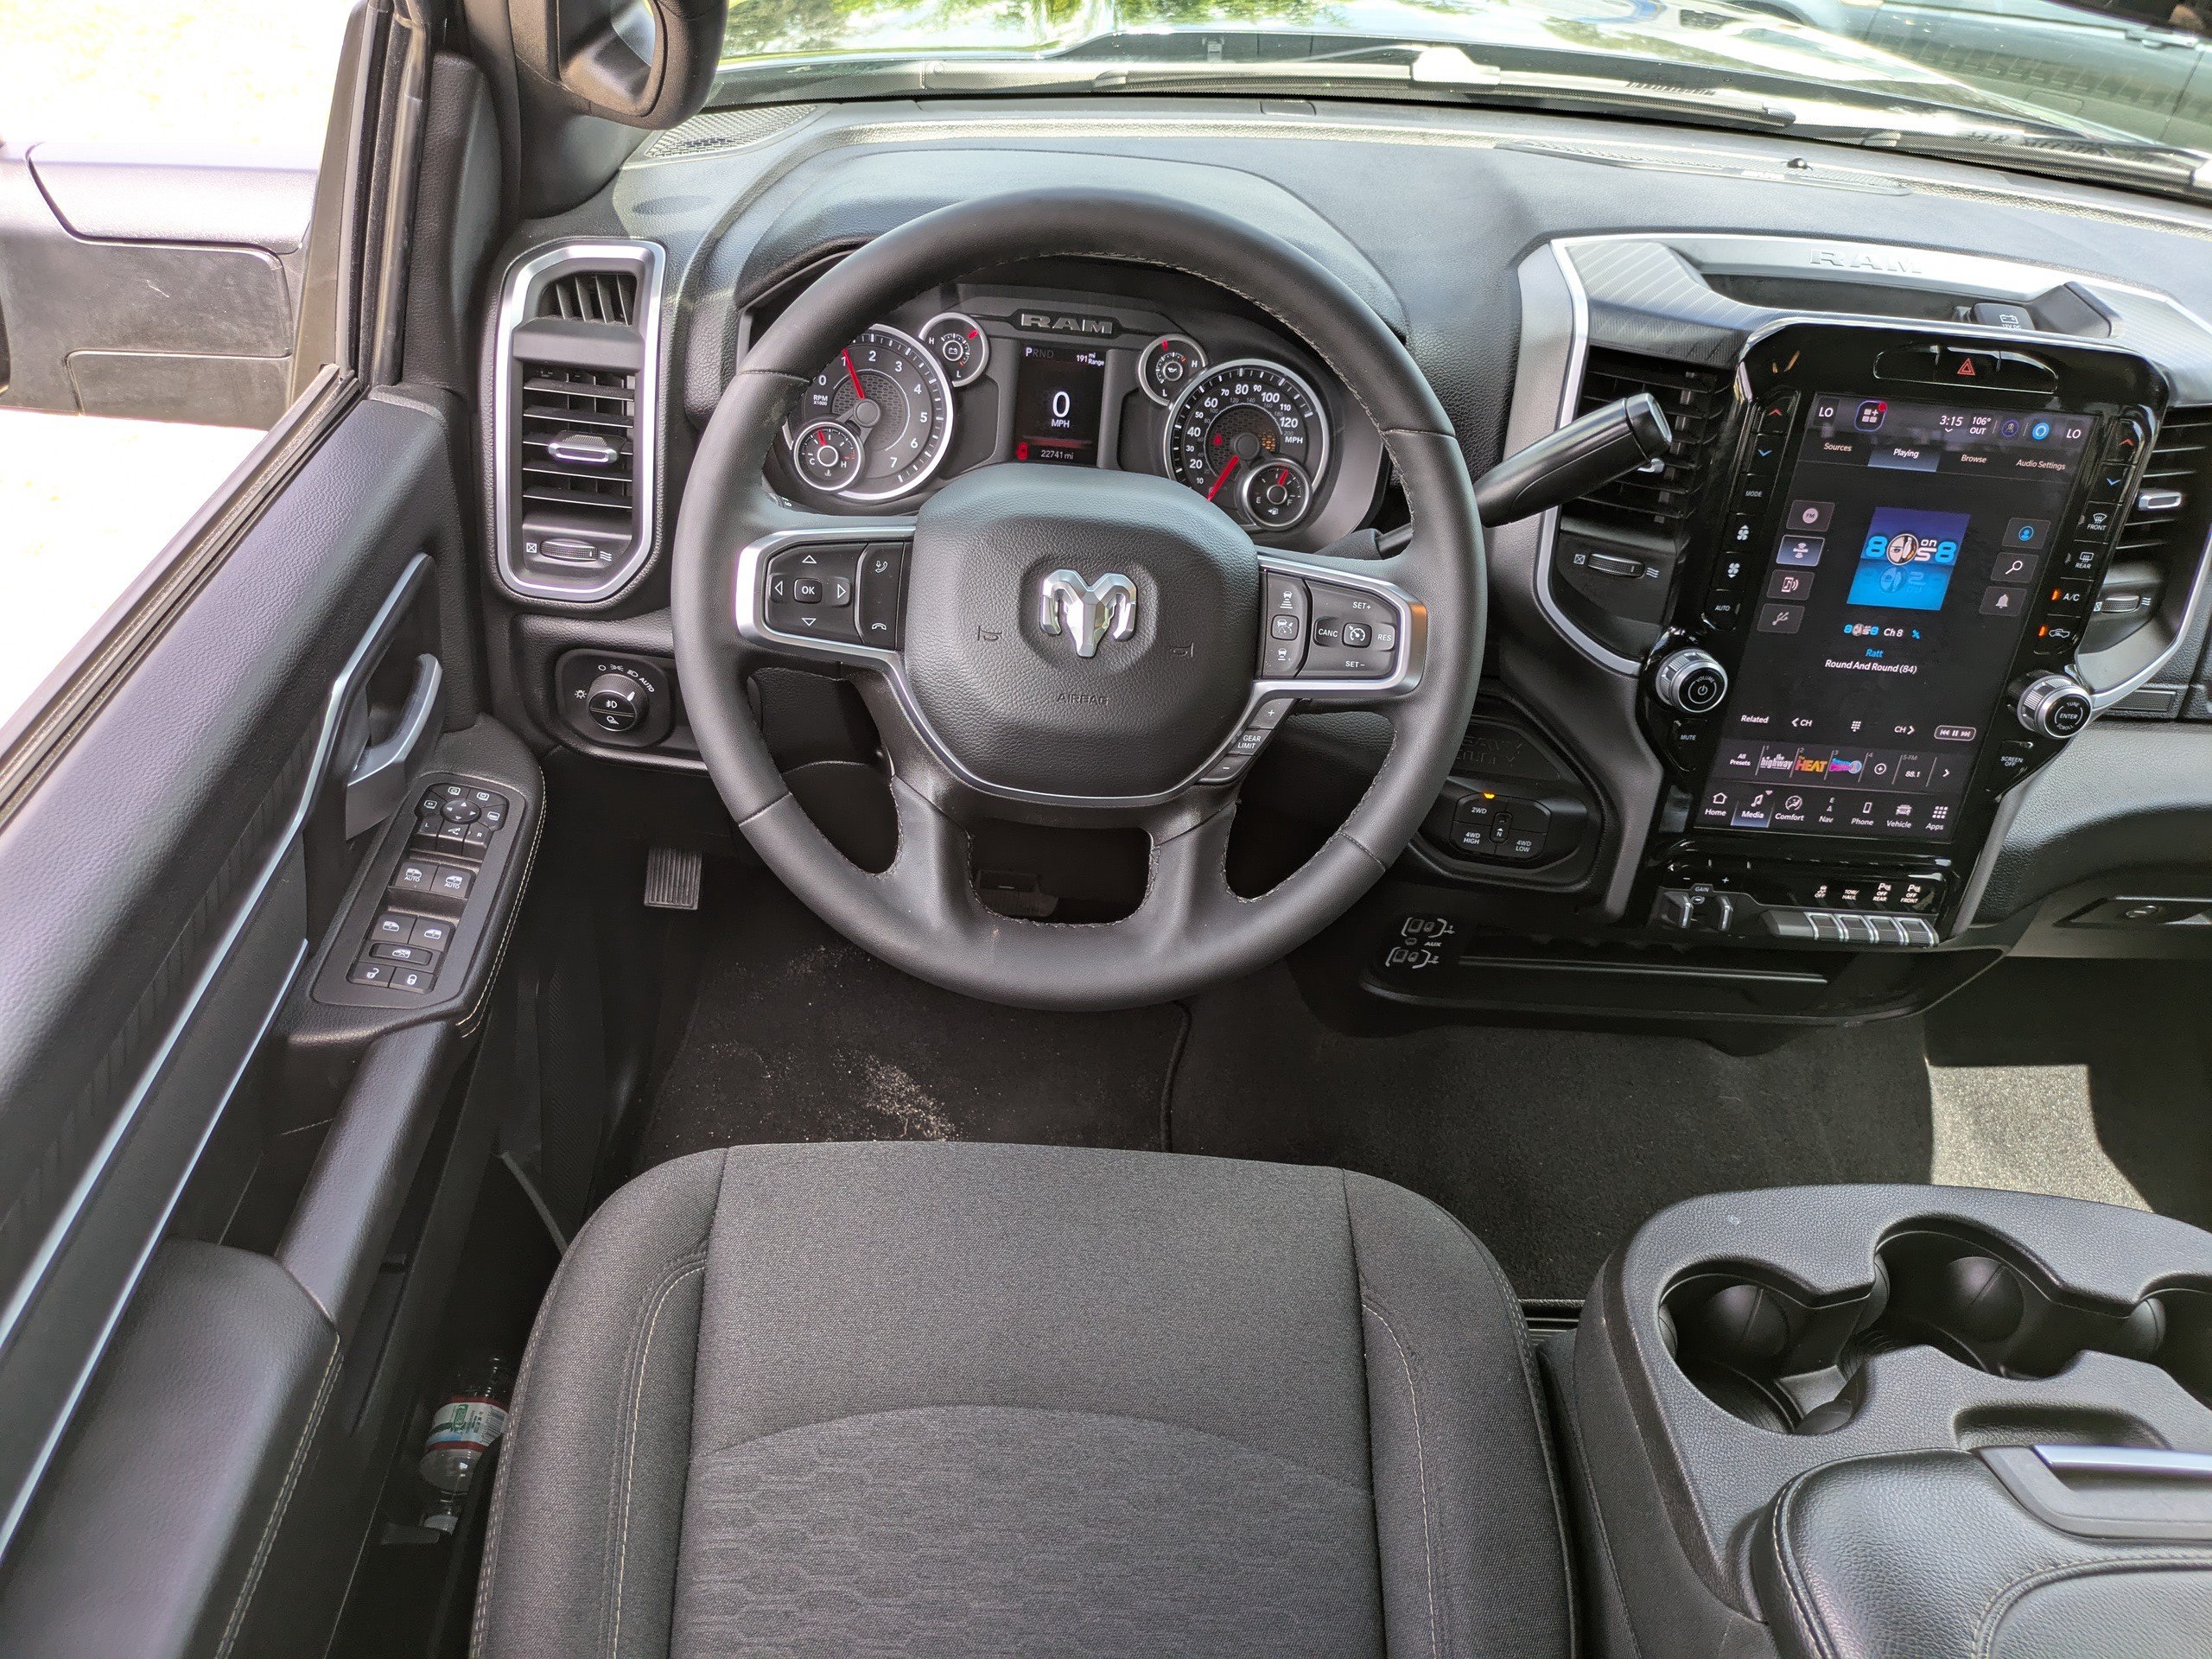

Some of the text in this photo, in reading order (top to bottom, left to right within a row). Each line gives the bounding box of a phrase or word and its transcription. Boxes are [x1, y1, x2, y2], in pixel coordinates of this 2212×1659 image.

[1810, 249, 1922, 274] RAM
[1021, 314, 1112, 334] RAM
[868, 352, 875, 362] 2
[895, 362, 902, 372] 3
[819, 375, 826, 385] 0
[914, 385, 922, 394] 4
[1235, 385, 1249, 395] 80
[1205, 397, 1218, 408] 60
[1262, 392, 1280, 403] 100
[1052, 391, 1070, 417] 0
[1819, 407, 1834, 418] LO
[920, 413, 927, 423] 5
[1280, 417, 1298, 428] 120
[1939, 416, 1962, 427] 3:15
[1972, 416, 1991, 425] 106°
[1052, 419, 1070, 428] MPH
[1187, 427, 1200, 436] 40
[2066, 429, 2081, 438] LO
[911, 439, 918, 448] 6
[1823, 442, 1852, 452] Sources
[1041, 450, 1063, 459] 22741
[1893, 448, 1919, 459] Playing
[1961, 454, 1986, 463] Browse
[890, 458, 897, 467] 7
[1190, 460, 1202, 469] 20
[2016, 459, 2066, 471] Audio Settings
[802, 586, 815, 594] OK
[2063, 593, 2080, 601] A/C
[1319, 628, 1338, 638] CANC
[1378, 633, 1391, 642] RES
[1897, 629, 1904, 638] 8
[1866, 649, 1885, 658] Ratt
[1825, 659, 1916, 674] Round And Round (84)
[639, 677, 655, 692] AUTO
[1055, 693, 1109, 706] AIRBAG
[1741, 715, 1770, 724] Related
[1760, 756, 1793, 769] highway
[1795, 760, 1827, 772] HEAT
[1705, 808, 1726, 817] Home
[1741, 810, 1764, 819] Media
[1775, 812, 1804, 822] Comfort
[1851, 817, 1873, 827] Phone
[1886, 820, 1911, 829] Vehicle
[1925, 823, 1943, 832] Apps
